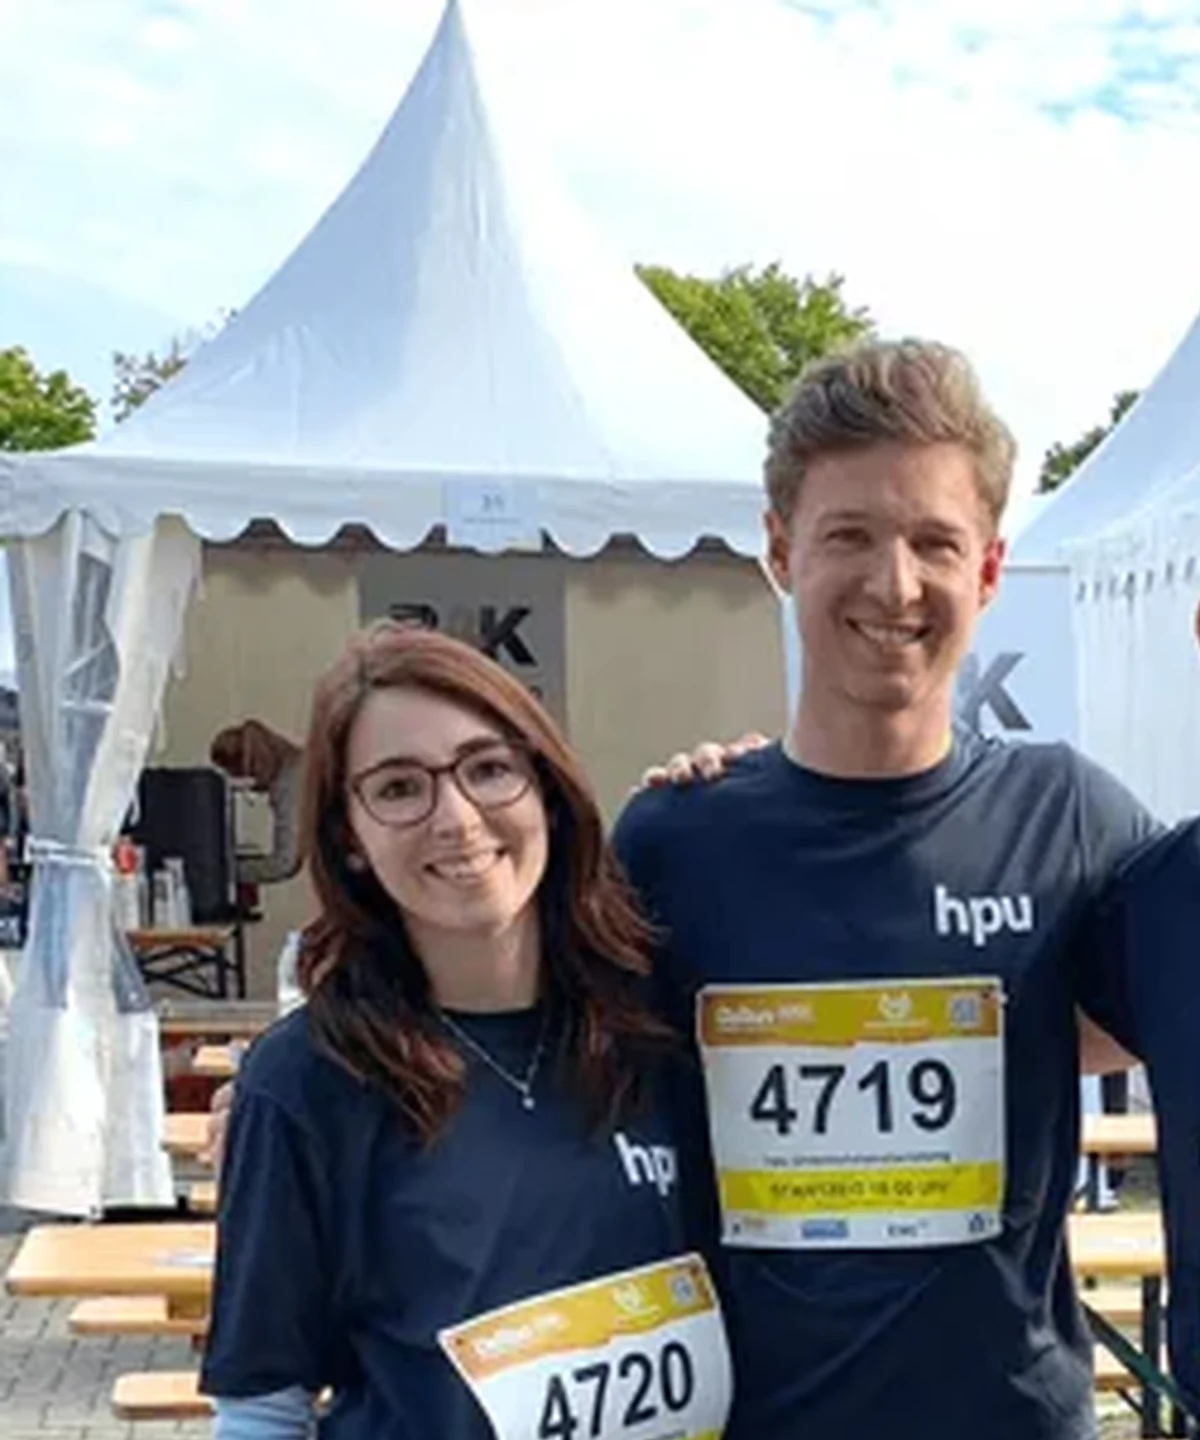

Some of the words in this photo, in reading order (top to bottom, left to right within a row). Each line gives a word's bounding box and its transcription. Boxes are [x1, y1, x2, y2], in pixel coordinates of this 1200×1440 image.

[934, 884, 1033, 946] hpu
[750, 1059, 957, 1136] 4719
[613, 1132, 677, 1197] hp
